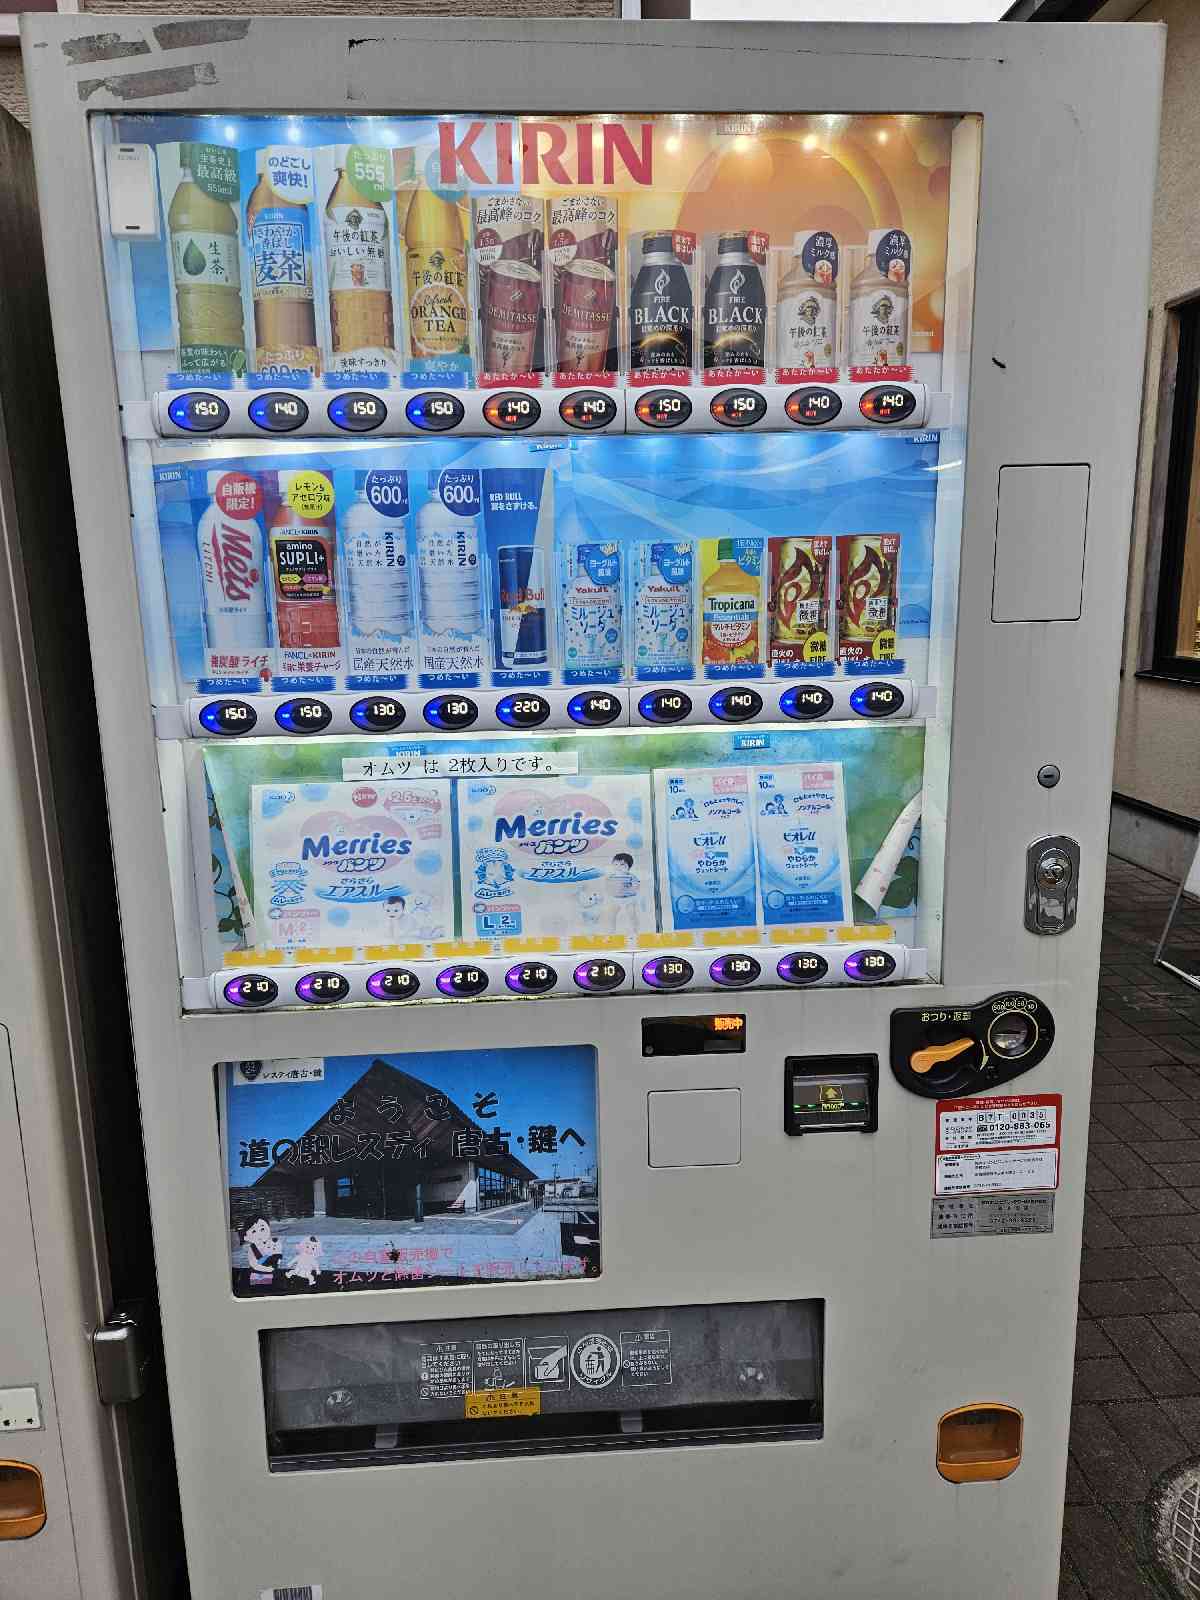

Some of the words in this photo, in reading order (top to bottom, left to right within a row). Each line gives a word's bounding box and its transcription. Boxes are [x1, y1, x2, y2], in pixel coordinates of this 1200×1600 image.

[438, 121, 656, 186] KIRIN
[269, 155, 311, 170] のどこし
[476, 208, 542, 225] 最高峰のコク
[551, 208, 616, 225] 最高峰のコク
[333, 230, 379, 244] 午後の紅茶
[207, 240, 225, 275] 生茶
[255, 250, 303, 281] 麦茶
[412, 271, 467, 287] 午後の紅茶
[411, 306, 467, 321] ORANGE
[634, 306, 690, 325] BLACK
[708, 306, 764, 325] BLACK
[424, 319, 456, 333] TEA
[789, 326, 829, 339] 午後の紅茶
[863, 325, 901, 337] 午後の紅茶
[507, 400, 530, 414] 140
[583, 399, 606, 413] 140
[659, 398, 681, 411] 150
[733, 397, 755, 411] 150
[808, 395, 830, 409] 140
[883, 393, 904, 407] 140
[195, 401, 220, 416] 150
[274, 402, 298, 416] 140
[353, 401, 377, 415] 150
[431, 401, 454, 415] 150
[371, 474, 402, 484] たっぷり
[444, 474, 474, 483] たっぷり
[222, 482, 257, 496] 自販機
[371, 486, 402, 504] 600
[444, 485, 474, 503] 600
[489, 493, 504, 501] RED
[225, 498, 255, 511] 限定!
[384, 532, 397, 567] KIRIN
[456, 532, 468, 567] KIRIN
[279, 551, 325, 566] SUPLI+
[590, 559, 618, 568] ヨーグルト
[664, 558, 690, 567] ヨーグルト
[575, 586, 609, 594] Yakult
[647, 585, 682, 593] Yakult
[708, 597, 755, 612] Tropicana
[712, 621, 752, 631] マルチビタミン
[353, 657, 415, 672] 国産天然水
[424, 656, 484, 671] 国産天然水
[661, 697, 681, 708] 140
[731, 694, 752, 707] 140
[802, 692, 823, 704] 140
[871, 690, 893, 702] 140
[300, 706, 322, 717] 150
[373, 703, 396, 715] 130
[447, 701, 468, 714] 130
[513, 700, 540, 712] 220
[590, 698, 611, 711] 140
[225, 707, 247, 720] 150
[741, 738, 766, 747] KIRIN
[362, 761, 411, 777] オムツ
[423, 759, 439, 774] は
[448, 755, 553, 773] 2枚入りです。
[669, 786, 679, 794] 10
[759, 781, 770, 790] 10
[494, 811, 619, 843] Merries
[301, 832, 413, 861] Merries
[534, 838, 589, 855] パンツ
[336, 857, 386, 873] パンツ
[787, 854, 816, 863] やわらか
[526, 866, 597, 880] エアスルー
[327, 884, 401, 898] エアスルー
[483, 916, 496, 929] L
[663, 963, 683, 974] 130
[731, 960, 751, 972] 130
[798, 958, 818, 969] 130
[865, 956, 884, 967] 130
[454, 971, 479, 983] 210
[522, 968, 548, 980] 210
[590, 965, 615, 977] 210
[313, 977, 340, 989] 210
[384, 974, 410, 986] 210
[242, 982, 269, 993] 210
[921, 1011, 972, 1023] おつり・返却
[329, 1090, 499, 1126] ようこそ
[239, 1133, 433, 1169] 道の駅レスティ
